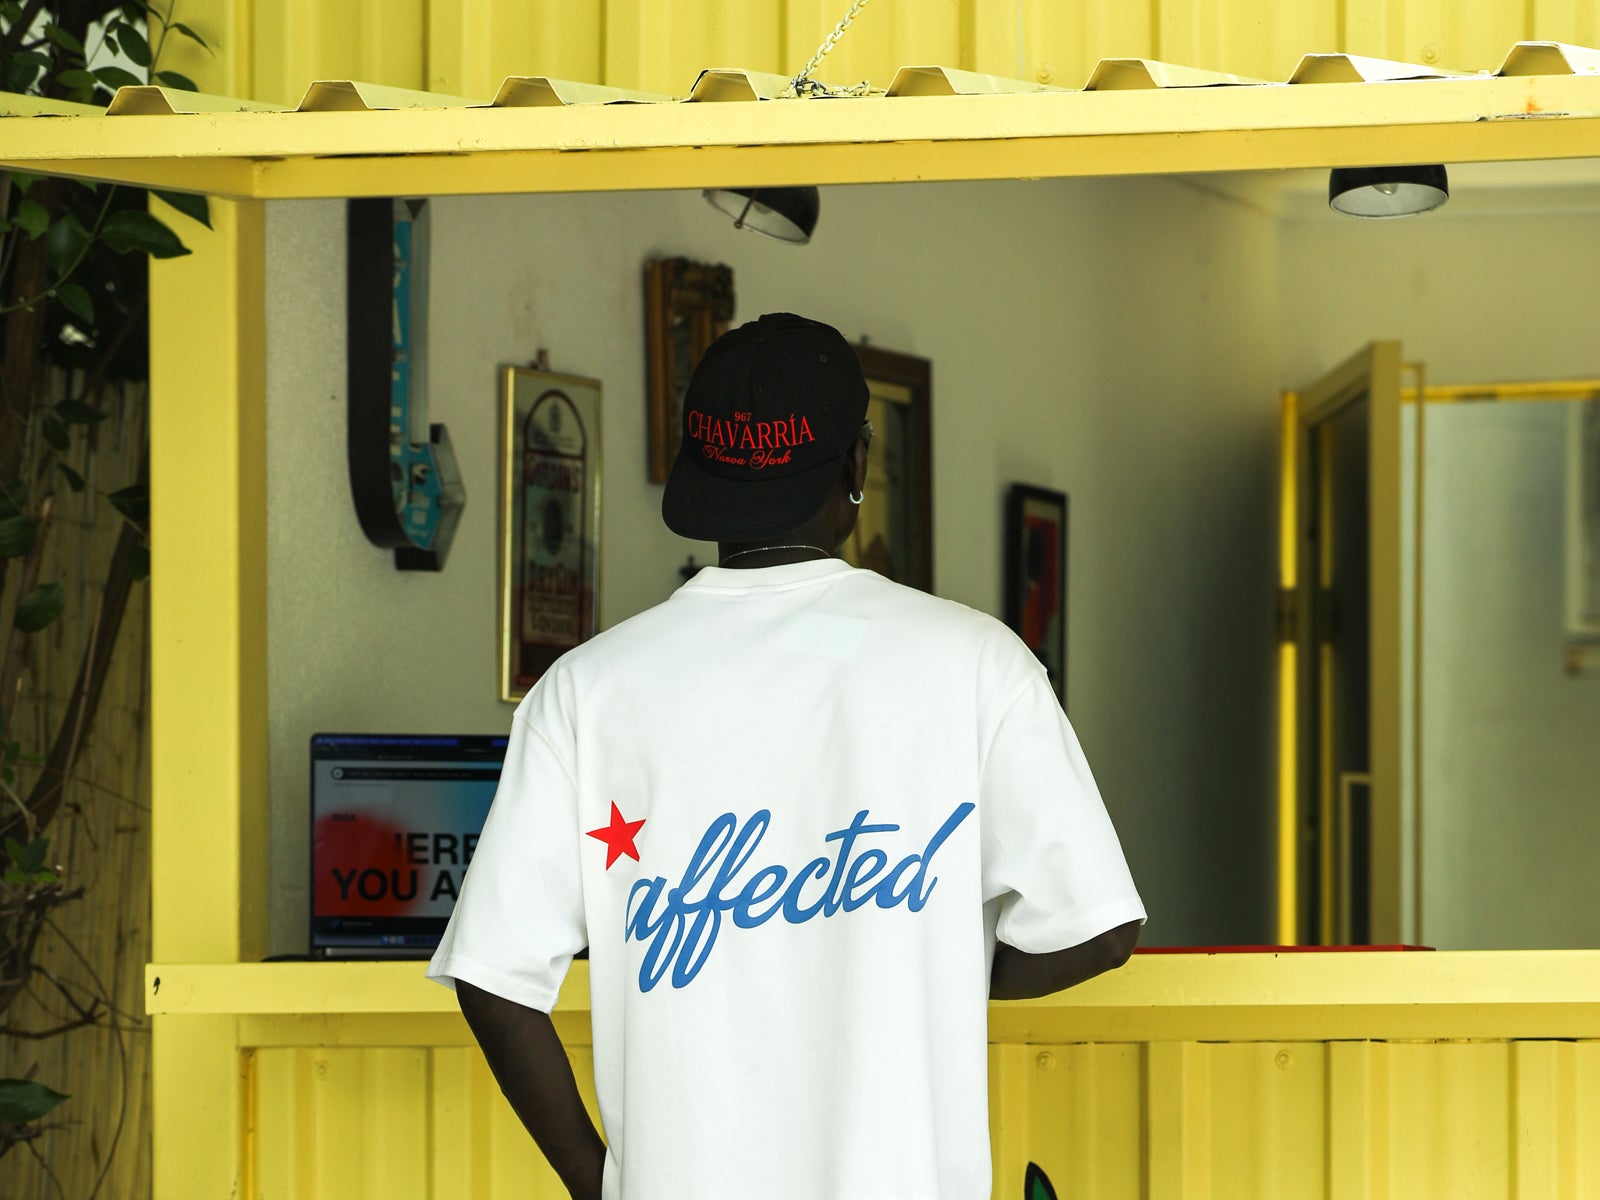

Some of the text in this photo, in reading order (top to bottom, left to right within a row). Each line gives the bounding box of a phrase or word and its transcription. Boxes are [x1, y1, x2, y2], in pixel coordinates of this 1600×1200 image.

[688, 410, 816, 449] CHAVARRÍA
[734, 411, 752, 422] 967
[749, 448, 792, 470] York
[332, 868, 418, 903] YOU
[625, 802, 975, 993] affected
